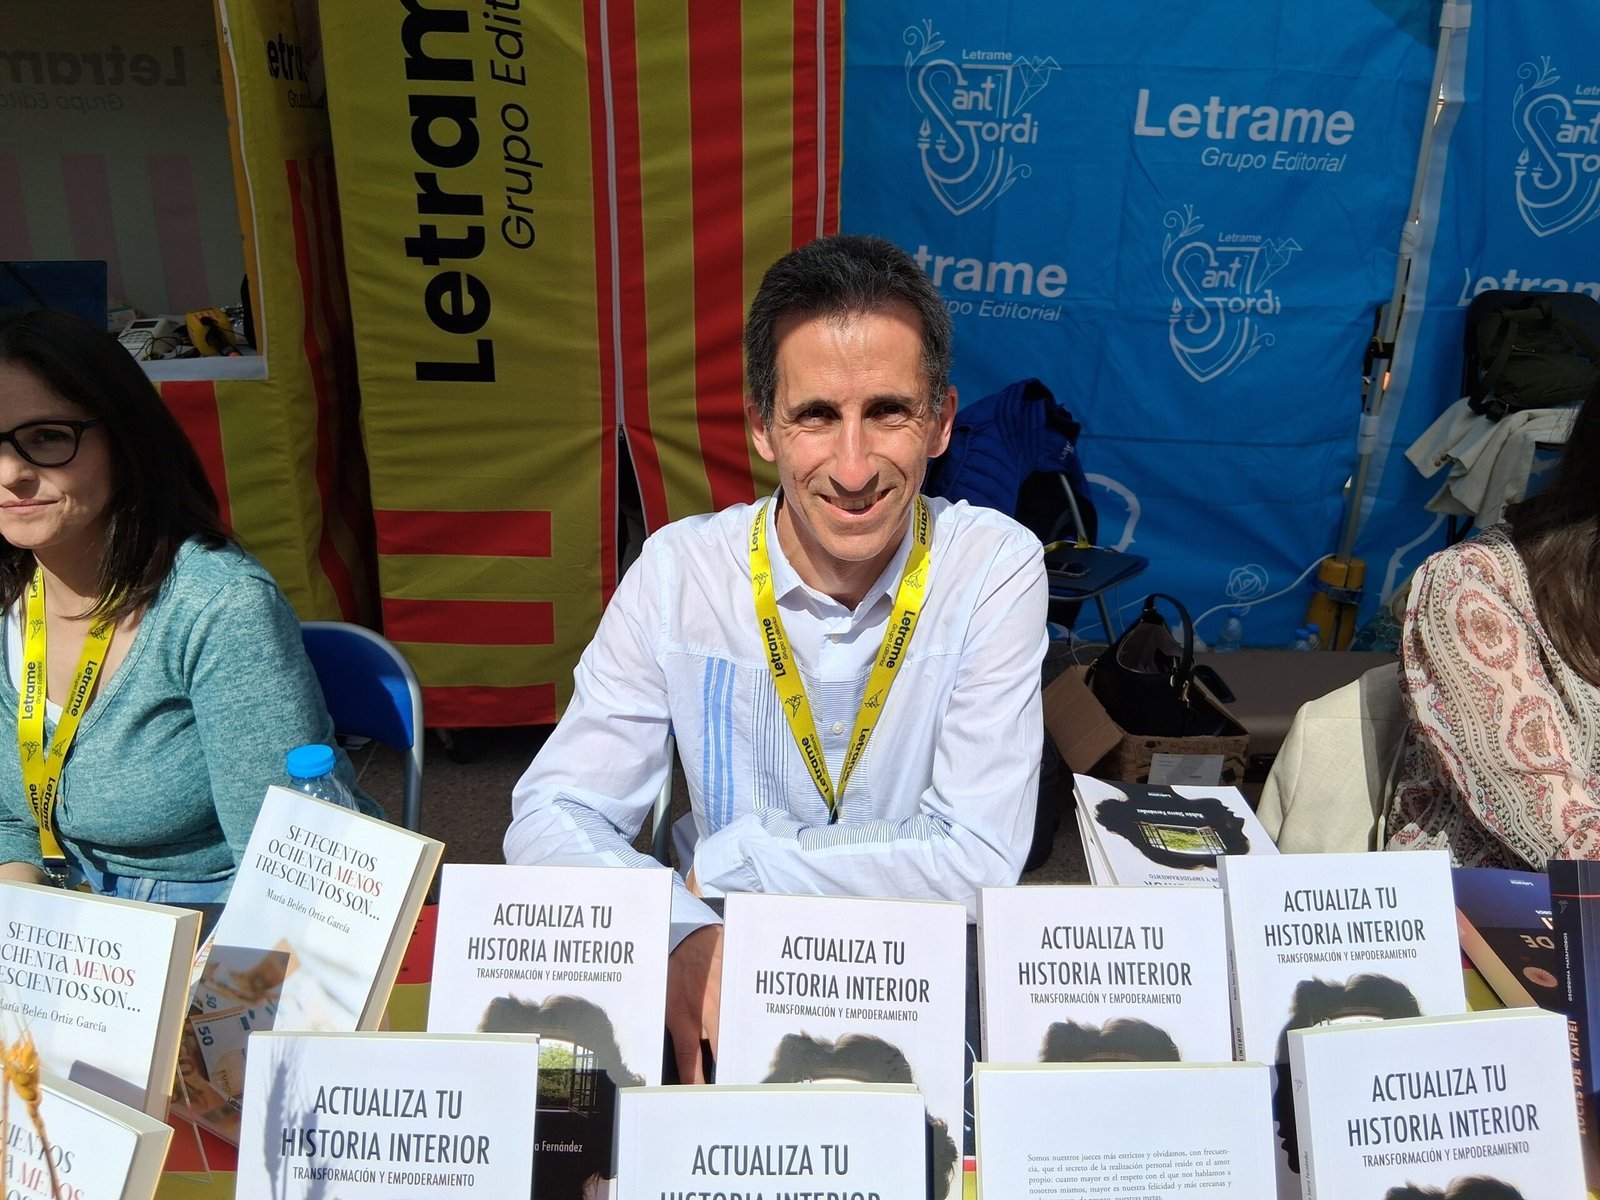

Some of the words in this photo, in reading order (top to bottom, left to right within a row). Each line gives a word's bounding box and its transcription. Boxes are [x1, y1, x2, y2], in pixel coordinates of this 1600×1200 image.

[482, 0, 527, 87] Edit
[961, 48, 1013, 61] Letrame
[1575, 84, 1600, 96] Letr
[1134, 88, 1355, 146] Letrame
[1200, 146, 1266, 173] Grupo
[1271, 150, 1348, 173] Editorial
[401, 0, 496, 383] Letram
[500, 102, 544, 250] Grupo
[1217, 231, 1262, 243] Letrame
[912, 244, 1068, 298] trame
[978, 299, 1062, 321] Editorial
[762, 617, 787, 678] Letrame
[886, 609, 916, 669] Letrame
[21, 661, 36, 720] Letrame
[71, 660, 98, 717] Letrame
[801, 736, 830, 794] Letrame
[286, 824, 378, 872] SETECIENTOS
[255, 853, 345, 904] TRESCIENTOS
[342, 891, 380, 921] SON...
[334, 864, 383, 897] MENOS
[265, 888, 286, 905] María
[286, 897, 307, 914] Belén
[308, 907, 326, 922] Ortiz
[326, 915, 351, 934] García
[1284, 888, 1372, 913] ACTUALIZA
[1375, 886, 1398, 909] TU
[493, 903, 584, 928] ACTUALIZA
[590, 905, 613, 929] TU
[6, 921, 123, 960] SETECIENTOS
[1040, 926, 1136, 950] ACTUALIZA
[1140, 926, 1164, 950] TU
[1264, 922, 1343, 947] HISTORIA
[1346, 919, 1426, 944] INTERIOR
[0, 943, 69, 974] CHENTa
[72, 958, 136, 987] MENOS
[467, 937, 547, 962] HISTORIA
[553, 939, 635, 965] INTERIOR
[781, 935, 877, 964] ACTUALIZA
[883, 940, 905, 965] TU
[1277, 950, 1342, 964] TRANSFORMACIÓN
[1343, 951, 1349, 961] Y
[1350, 948, 1417, 961] EMPODERAMIENTO
[1563, 932, 1571, 969] MATAMOROS
[0, 964, 90, 1001] ESCIENTOS
[91, 985, 141, 1013] SON...
[477, 968, 543, 981] TRANSFORMACIÓN
[545, 970, 551, 981] Y
[552, 970, 622, 982] EMPODERAMIENTO
[756, 970, 840, 999] HISTORIA
[846, 975, 930, 1003] INTERIOR
[1018, 961, 1102, 986] HISTORIA
[1107, 961, 1193, 986] INTERIOR
[1566, 970, 1574, 1002] GEORGINA
[765, 1002, 836, 1018] TRANSFORMACIÓN
[838, 1007, 843, 1018] Y
[845, 1007, 918, 1022] EMPODERAMIENTO
[1030, 991, 1100, 1004] TRANSFORMACIÓN
[1102, 993, 1107, 1004] Y
[1109, 993, 1182, 1005] EMPODERAMIENTO
[22, 1003, 48, 1020] Belén
[50, 1010, 74, 1026] Ortiz
[76, 1015, 108, 1033] García
[198, 1025, 214, 1047] 50
[1235, 1026, 1245, 1057] INTERIOR
[1568, 1020, 1581, 1063] TAIPEI
[1372, 1067, 1478, 1103] ACTUALIZA
[1481, 1064, 1507, 1093] TU
[1571, 1067, 1584, 1087] DE
[313, 1085, 428, 1119] ACTUALIZA
[435, 1089, 463, 1119] TU
[1347, 1112, 1444, 1147] HISTORIA
[1448, 1103, 1540, 1139] INTERIOR
[280, 1127, 381, 1161] HISTORIA
[389, 1132, 490, 1165] INTERIOR
[541, 1140, 583, 1153] Fernández
[691, 1144, 814, 1176] ACTUALIZA
[820, 1144, 849, 1176] TU
[1027, 1153, 1050, 1161] Somos
[1081, 1153, 1101, 1162] jueces
[1103, 1152, 1116, 1160] más
[1118, 1151, 1145, 1159] estrictos
[1152, 1149, 1188, 1158] olvidamos,
[1203, 1147, 1230, 1156] frecuen-
[1362, 1147, 1443, 1168] TRANSFORMACIÓN
[1444, 1149, 1450, 1162] Y
[1453, 1141, 1530, 1161] EMPODERAMIENTO
[293, 1167, 376, 1184] TRANSFORMACIÓN
[379, 1170, 386, 1183] Y
[387, 1171, 475, 1187] EMPODERAMIENTO
[1027, 1165, 1040, 1173] cia,
[1042, 1166, 1055, 1174] que
[1056, 1164, 1063, 1172] el
[1090, 1163, 1099, 1171] de
[1101, 1163, 1107, 1171] la
[1109, 1162, 1143, 1170] realización
[1145, 1160, 1172, 1170] personal
[1174, 1160, 1193, 1168] reside
[1028, 1177, 1053, 1185] propio:
[1080, 1176, 1101, 1184] mayor
[1120, 1174, 1143, 1182] respeto
[1167, 1172, 1179, 1180] que
[1194, 1169, 1226, 1177] hablamos
[1060, 1186, 1087, 1194] mismos,
[1089, 1186, 1111, 1194] mayor
[1148, 1182, 1175, 1190] felicidad
[1227, 1180, 1232, 1188] y
